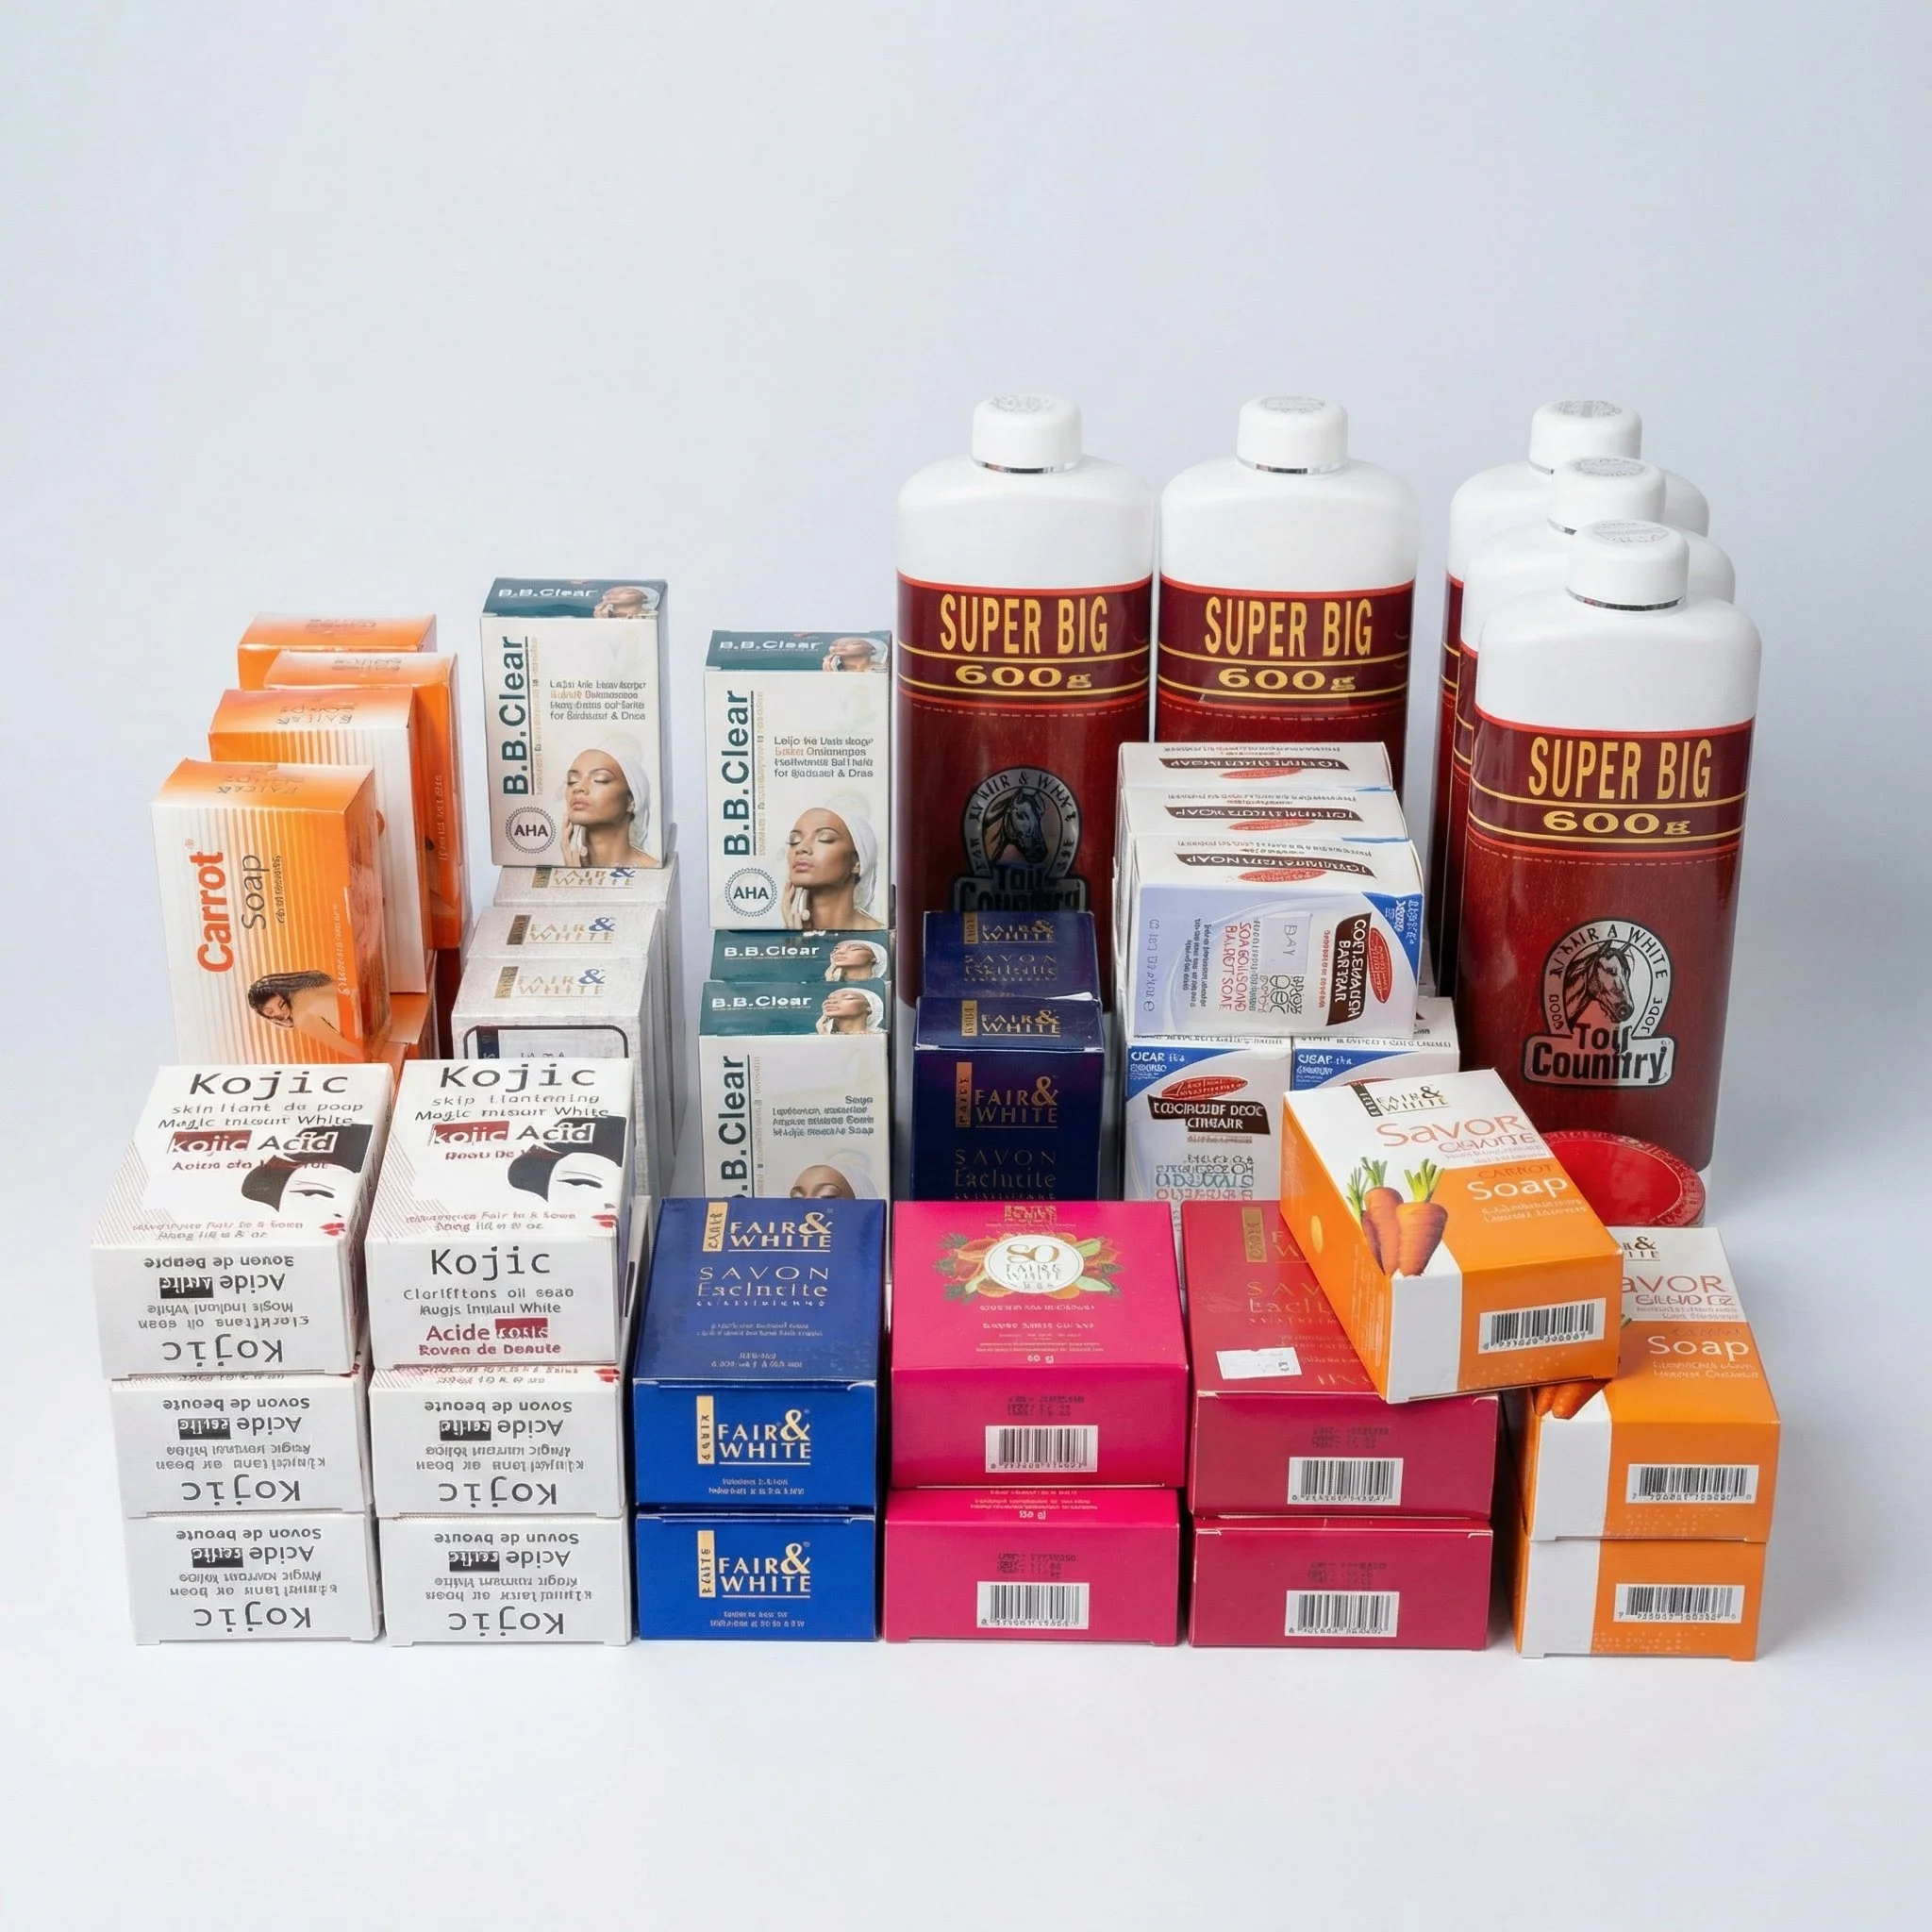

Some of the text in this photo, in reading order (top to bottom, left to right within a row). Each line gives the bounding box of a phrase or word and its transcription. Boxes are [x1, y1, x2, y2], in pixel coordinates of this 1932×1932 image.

[941, 593, 1108, 654] SUPER BIG
[1204, 596, 1373, 658] SUPER BIG
[499, 636, 529, 795] B.B.Clear
[722, 691, 753, 856] B.B.Clear
[1528, 737, 1712, 801] SUPER BIG
[514, 824, 549, 839] AHA
[241, 854, 271, 931] Soap
[733, 885, 769, 901] AHA
[197, 850, 235, 973] Carrot
[982, 1023, 1060, 1034] WHITE
[190, 1071, 348, 1101] Kojic
[440, 1063, 595, 1092] Kojic
[719, 1054, 748, 1198] .B.Clear
[975, 1108, 1058, 1124] WHITE
[258, 1131, 334, 1152] Acid
[516, 1123, 591, 1142] Acid
[956, 1149, 1056, 1166] SAVON
[1467, 1176, 1568, 1201] Soap
[730, 1235, 832, 1248] WHITE
[431, 1245, 550, 1281] Kojic
[700, 1266, 829, 1280] SAVON
[220, 1274, 285, 1294] Acide
[520, 1302, 561, 1314] White
[426, 1324, 490, 1341] Acide
[162, 1333, 283, 1366] Kojic
[1647, 1336, 1749, 1361] Soap
[230, 1399, 251, 1411] de
[491, 1402, 512, 1414] de
[236, 1417, 301, 1437] Acide
[497, 1420, 564, 1439] Acide
[719, 1442, 811, 1458] WHITE
[181, 1474, 300, 1506] Kojic
[438, 1475, 557, 1508] Kojic
[242, 1530, 263, 1541] de
[500, 1534, 520, 1545] de
[249, 1546, 314, 1564] Acide
[506, 1551, 571, 1569] Acide
[721, 1575, 811, 1592] WHITE
[193, 1601, 311, 1633] Kojic
[448, 1606, 564, 1637] Kojic
